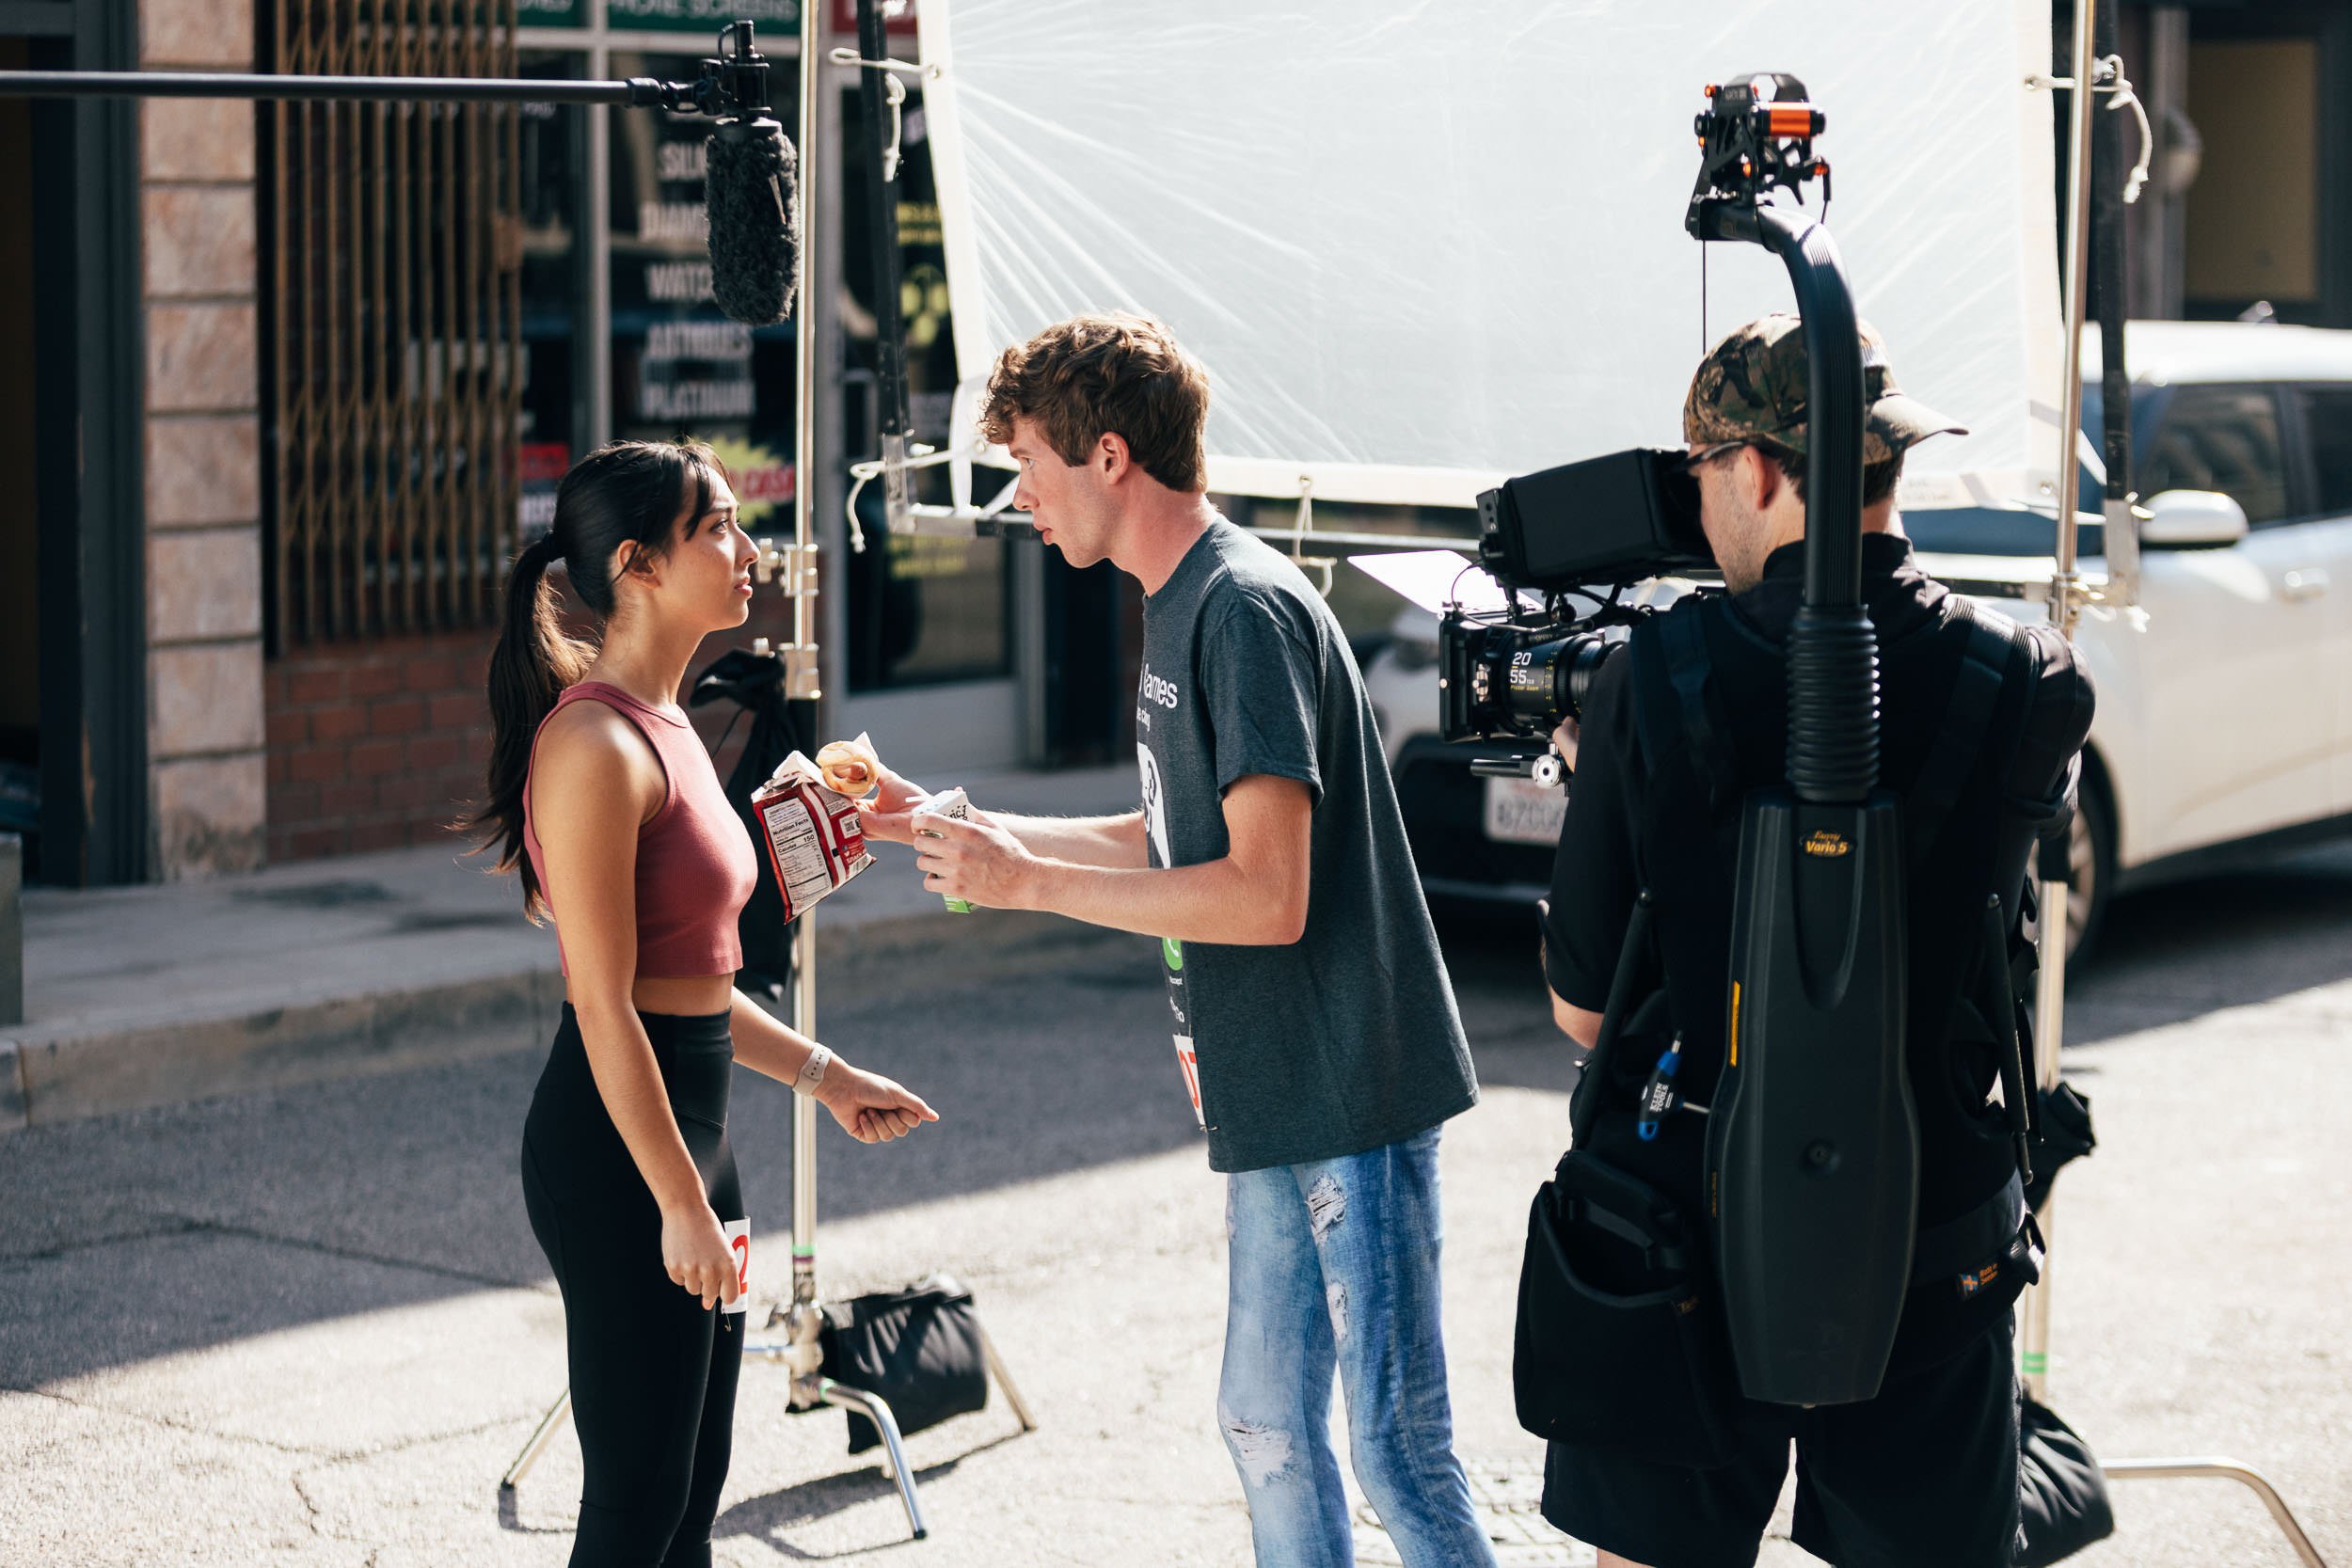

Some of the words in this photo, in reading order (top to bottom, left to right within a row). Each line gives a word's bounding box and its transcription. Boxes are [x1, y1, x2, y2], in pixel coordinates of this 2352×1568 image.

[1512, 652, 1532, 665] 20
[1510, 670, 1527, 684] 55
[1806, 841, 1836, 852] Vario
[1837, 842, 1848, 855] 5
[1649, 1082, 1663, 1111] KLEIN
[1656, 1084, 1669, 1113] TOOLS
